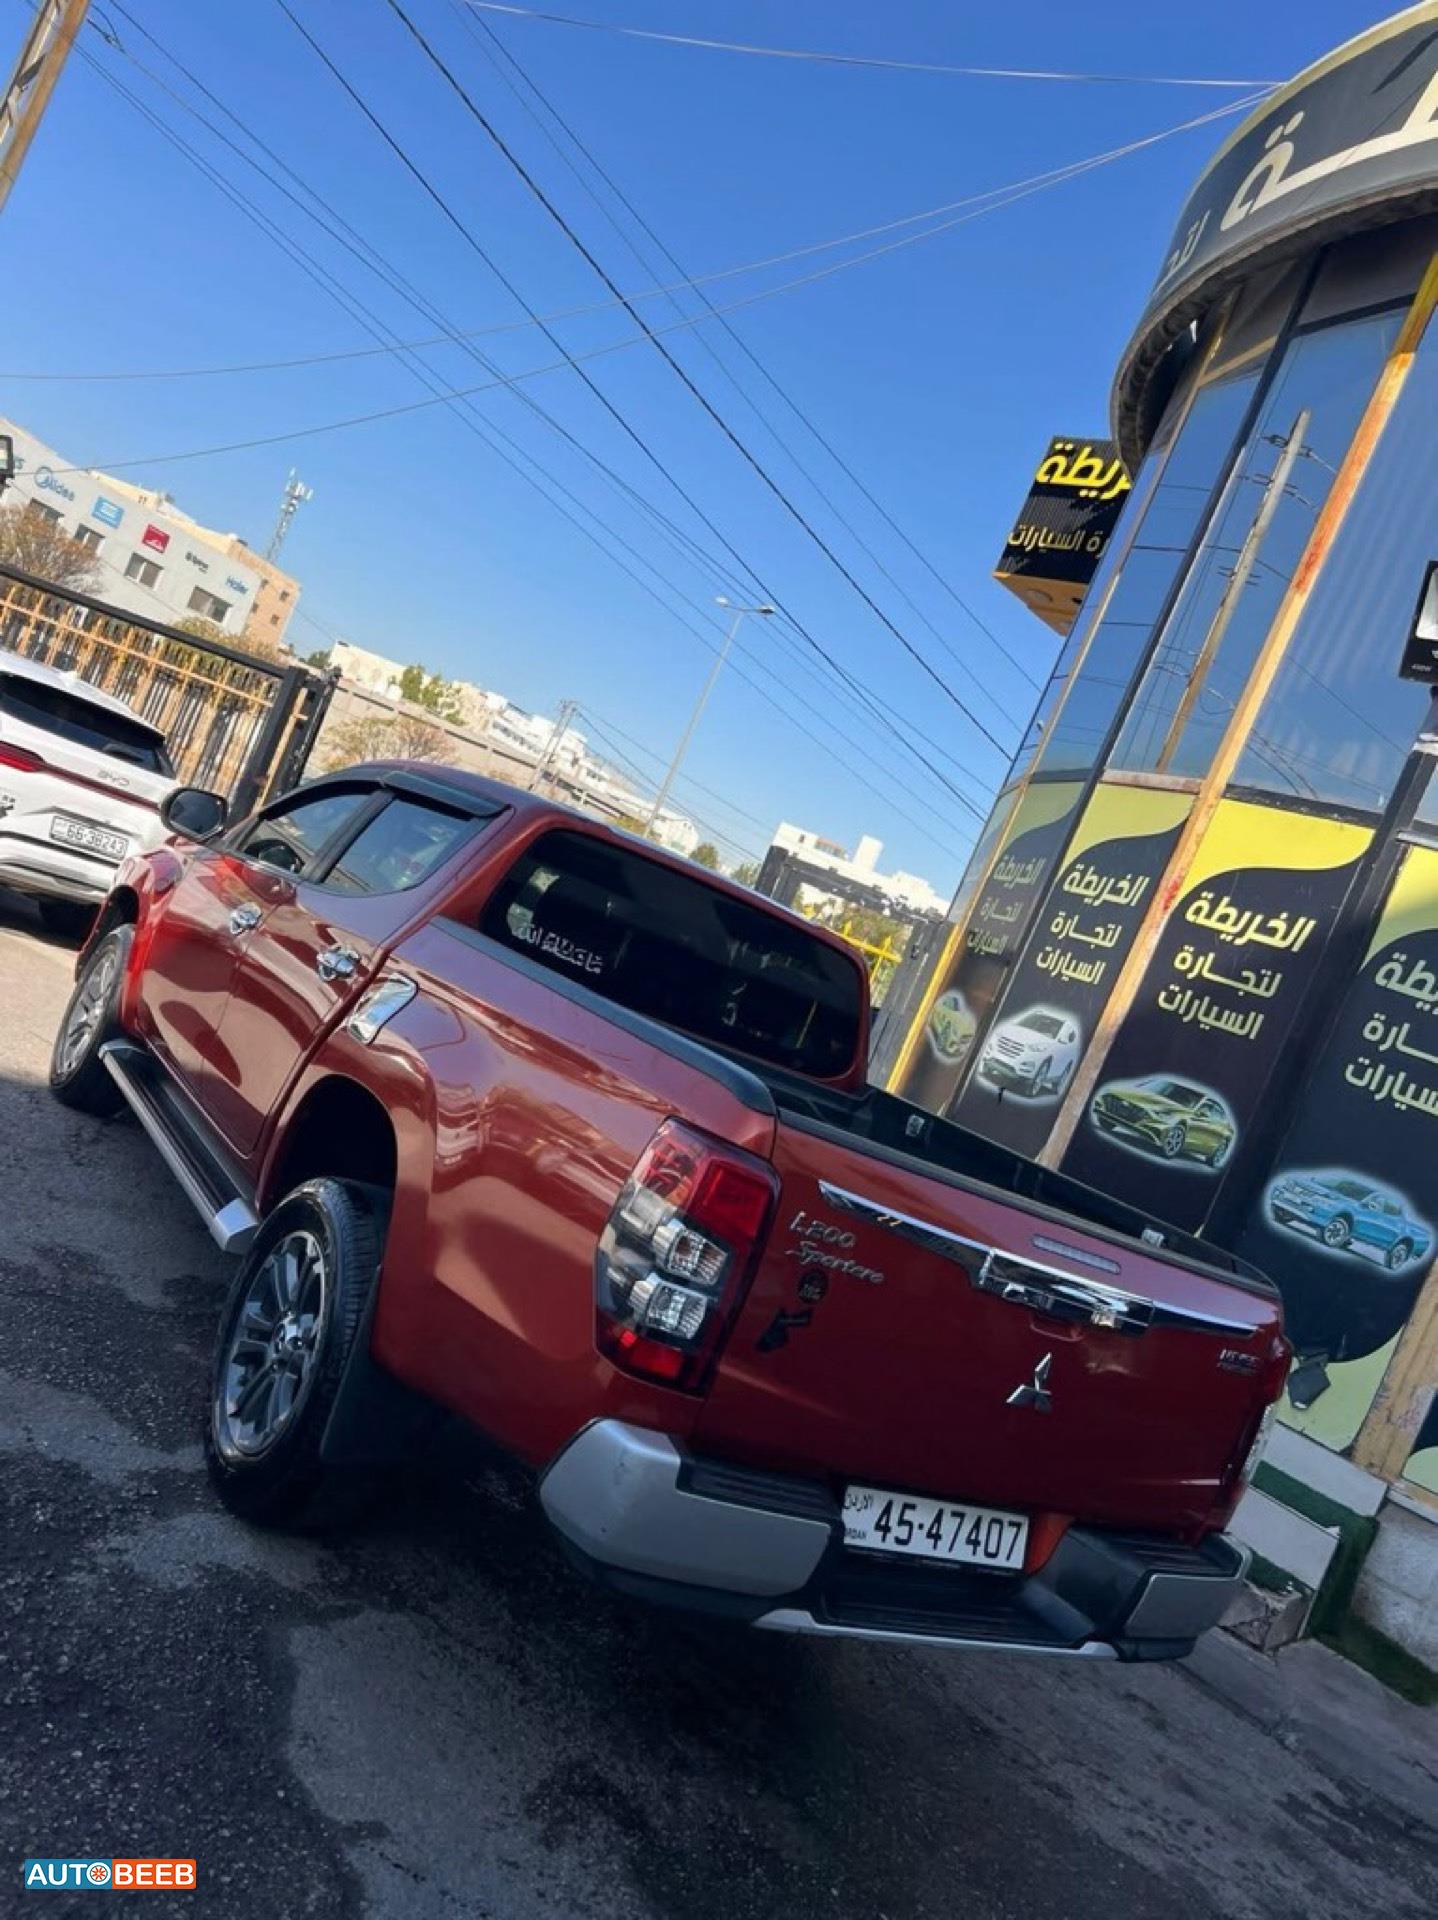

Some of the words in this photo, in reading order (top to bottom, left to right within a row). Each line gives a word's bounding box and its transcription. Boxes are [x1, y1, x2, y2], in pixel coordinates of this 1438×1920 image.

[1036, 443, 1132, 500] ريطة
[1008, 524, 1086, 553] السيارات
[1062, 863, 1151, 907] الخريطة
[1049, 910, 1122, 949] لتجارة
[1184, 890, 1317, 953] الخريطة
[1036, 946, 1107, 985] السيارات
[1173, 944, 1283, 999] لتجارة
[1158, 983, 1265, 1040] السيارات
[790, 1210, 856, 1248] L200
